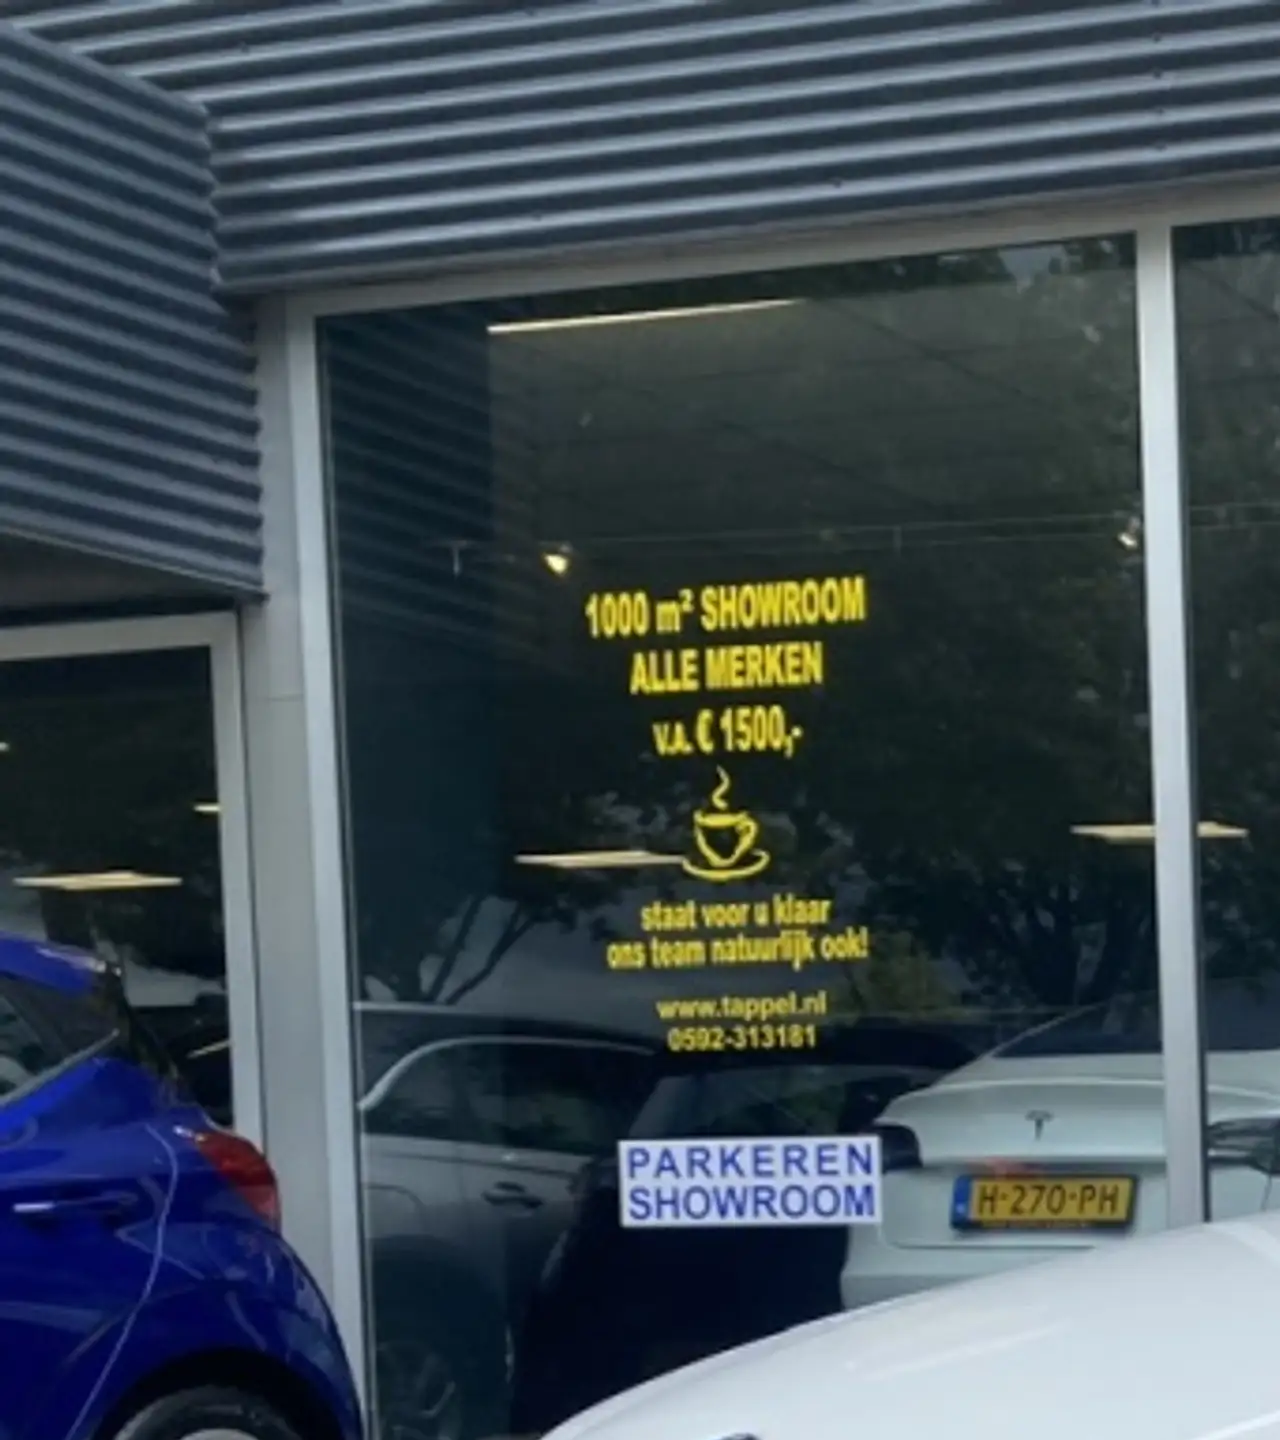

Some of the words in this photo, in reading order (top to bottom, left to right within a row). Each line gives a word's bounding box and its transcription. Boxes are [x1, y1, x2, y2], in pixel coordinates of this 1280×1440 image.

[585, 591, 649, 638] 1000
[700, 575, 867, 632] SHOWROOM
[630, 648, 699, 695] ALLE
[704, 641, 824, 690] MERKEN
[696, 709, 714, 754] €
[720, 705, 804, 759] 1500,-
[641, 900, 697, 931] staat
[702, 902, 749, 928] voor
[754, 902, 769, 926] u
[773, 893, 831, 925] klaar
[607, 941, 646, 969] ons
[651, 937, 705, 969] team
[711, 929, 815, 972] natuurlijk
[820, 926, 869, 961] ook!
[656, 990, 828, 1021] www.tappel.nl
[667, 1024, 816, 1052] 0592-313181
[627, 1143, 873, 1179] PARKEREN
[628, 1183, 875, 1221] SHOWROOM
[977, 1183, 1120, 1216] H-270-PH
